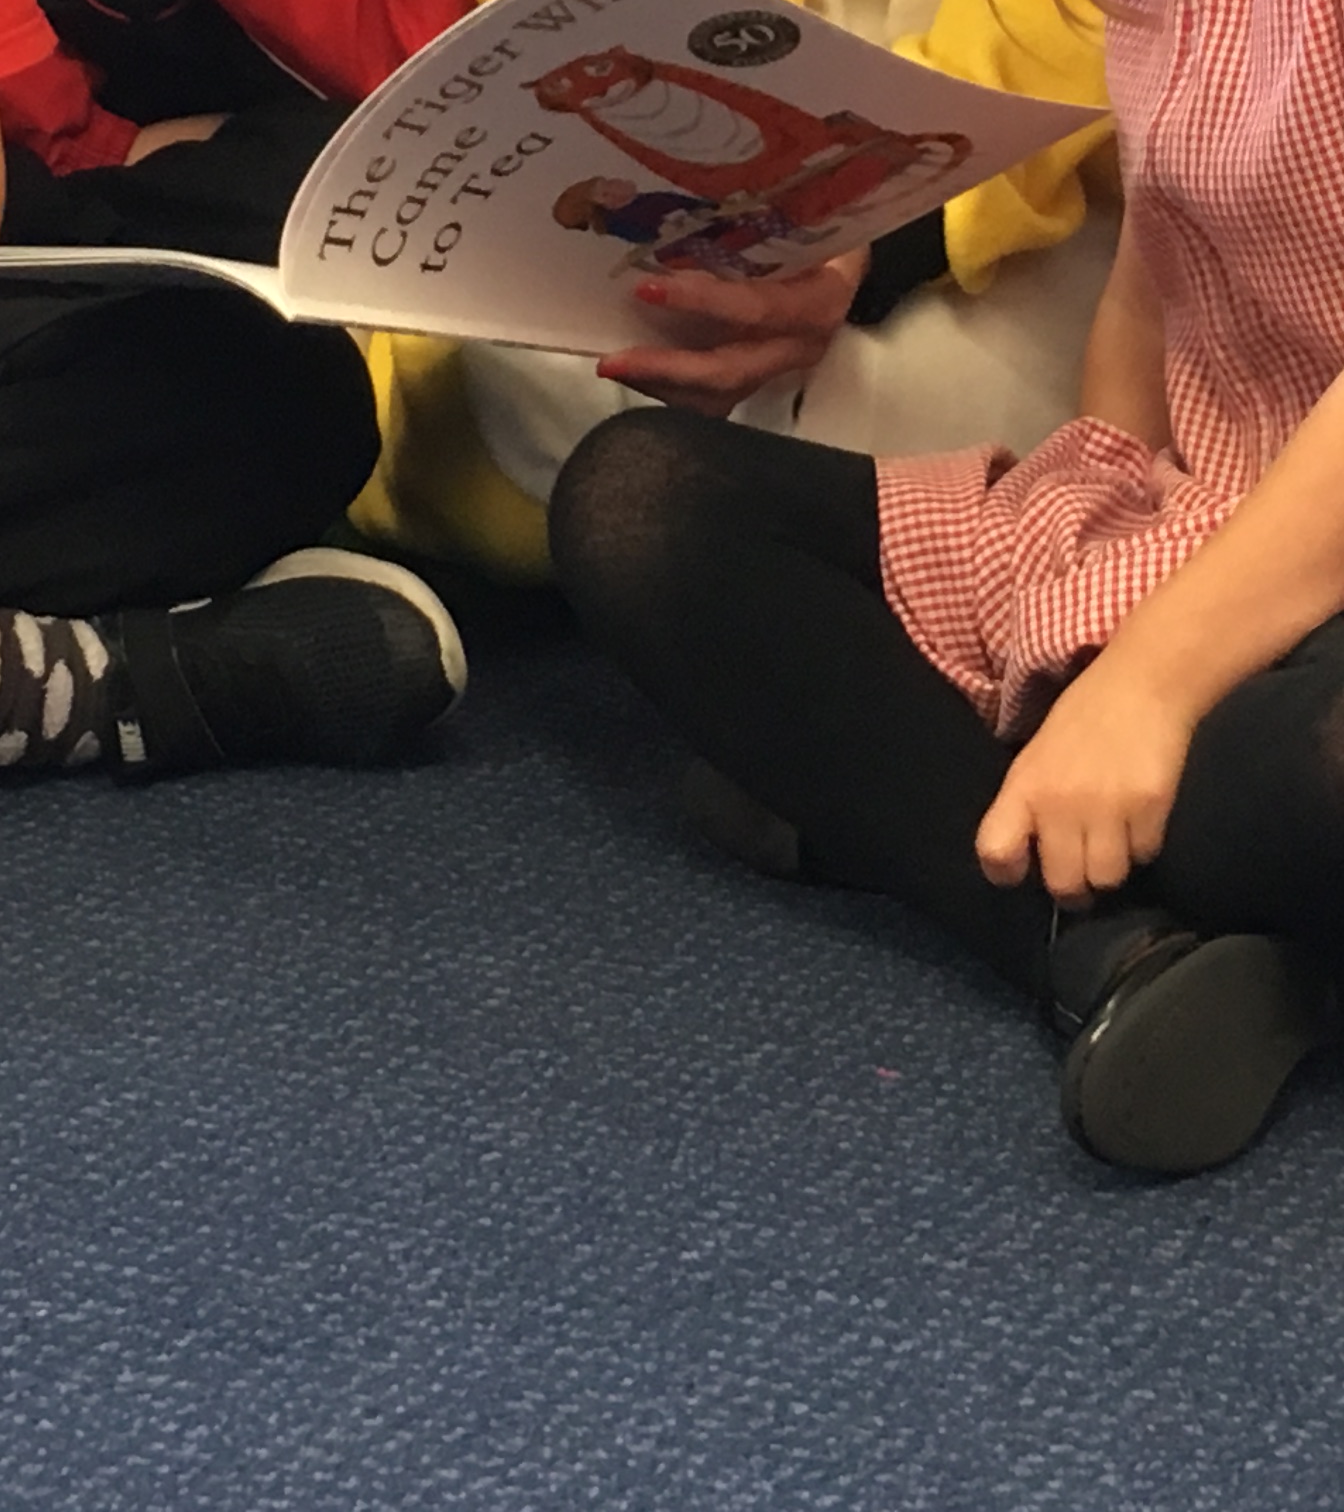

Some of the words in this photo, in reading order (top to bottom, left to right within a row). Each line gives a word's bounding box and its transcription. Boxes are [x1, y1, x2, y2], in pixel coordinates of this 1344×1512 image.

[713, 24, 776, 53] 50
[317, 154, 397, 261] The
[383, 38, 526, 141] Tiger
[371, 125, 488, 268] Came
[419, 221, 463, 274] to
[450, 131, 554, 206] Tea
